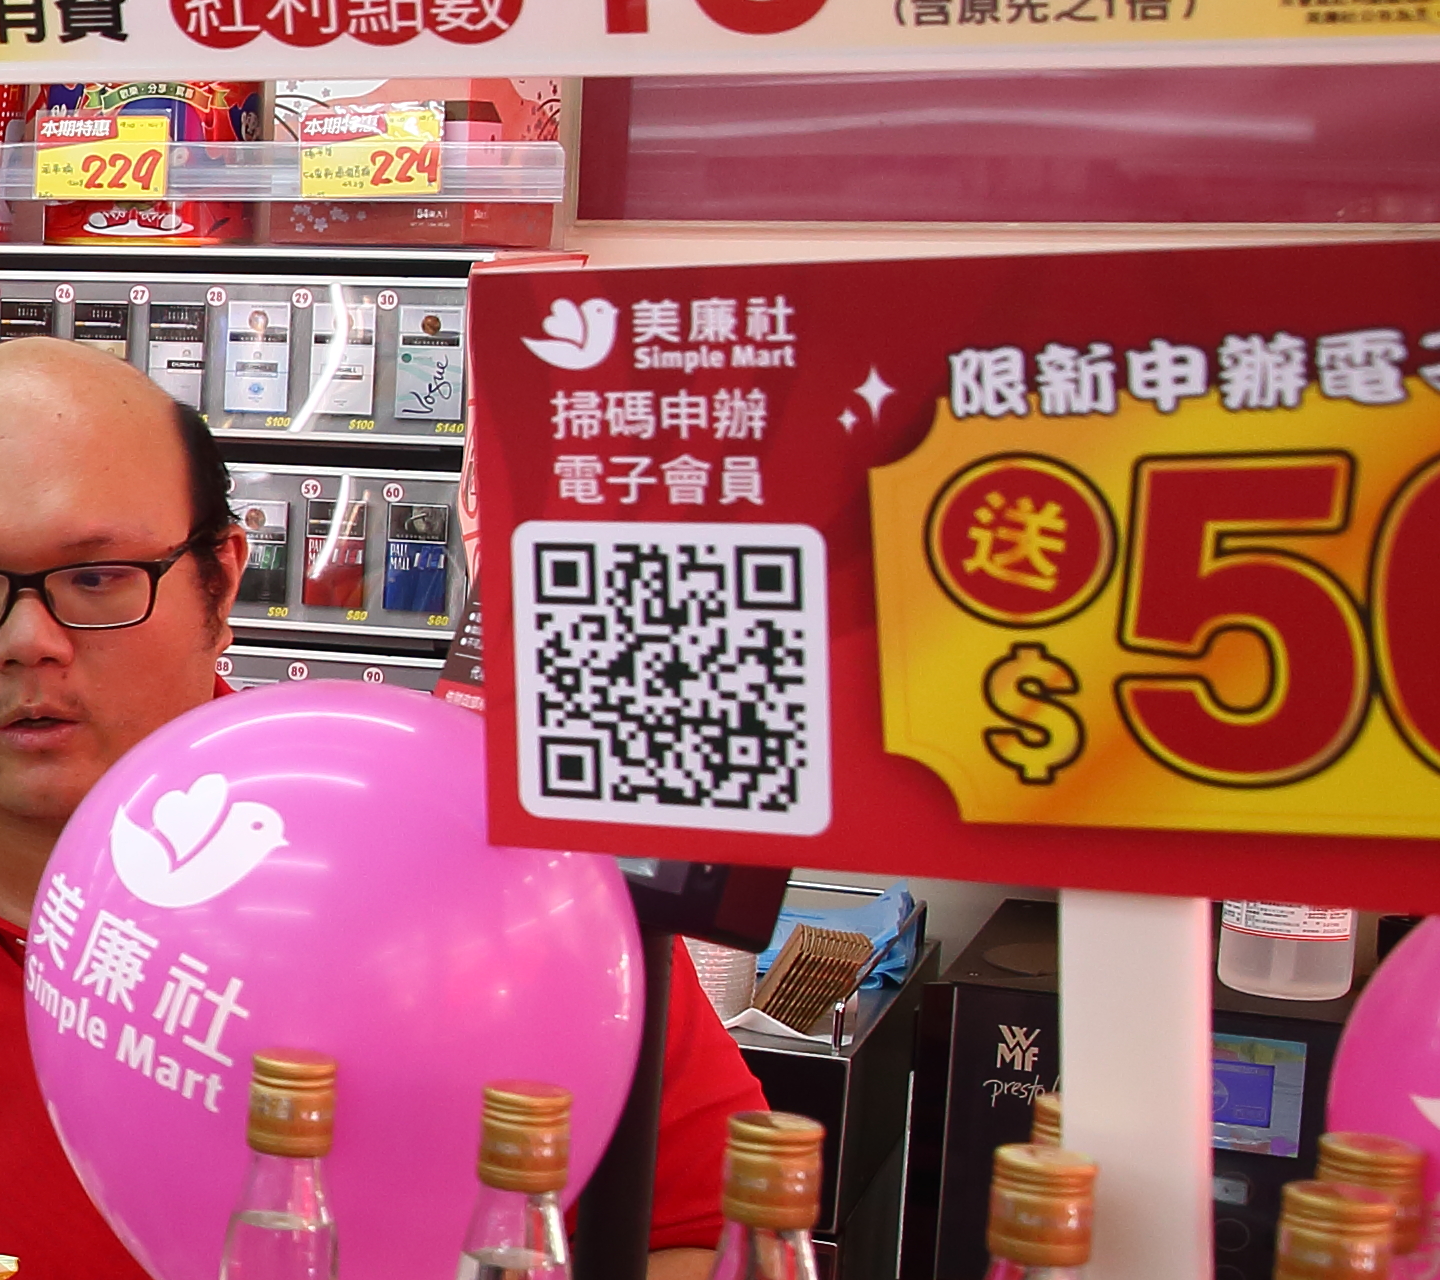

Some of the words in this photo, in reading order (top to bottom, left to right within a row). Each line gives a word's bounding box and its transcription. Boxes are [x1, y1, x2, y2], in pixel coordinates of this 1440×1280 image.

[40, 118, 111, 138] 本期特惠
[633, 296, 797, 344] 美廉社
[635, 344, 724, 374] Simple
[731, 340, 796, 370] Mart
[948, 326, 1440, 420] 限新申辦電
[550, 389, 768, 443] 掃碼申辦
[554, 454, 765, 508] 電子會員
[964, 490, 1067, 592] 送
[985, 643, 1085, 786] $
[30, 875, 250, 1067] 美廉社
[26, 967, 107, 1051] Simple
[115, 1031, 226, 1114] Mart
